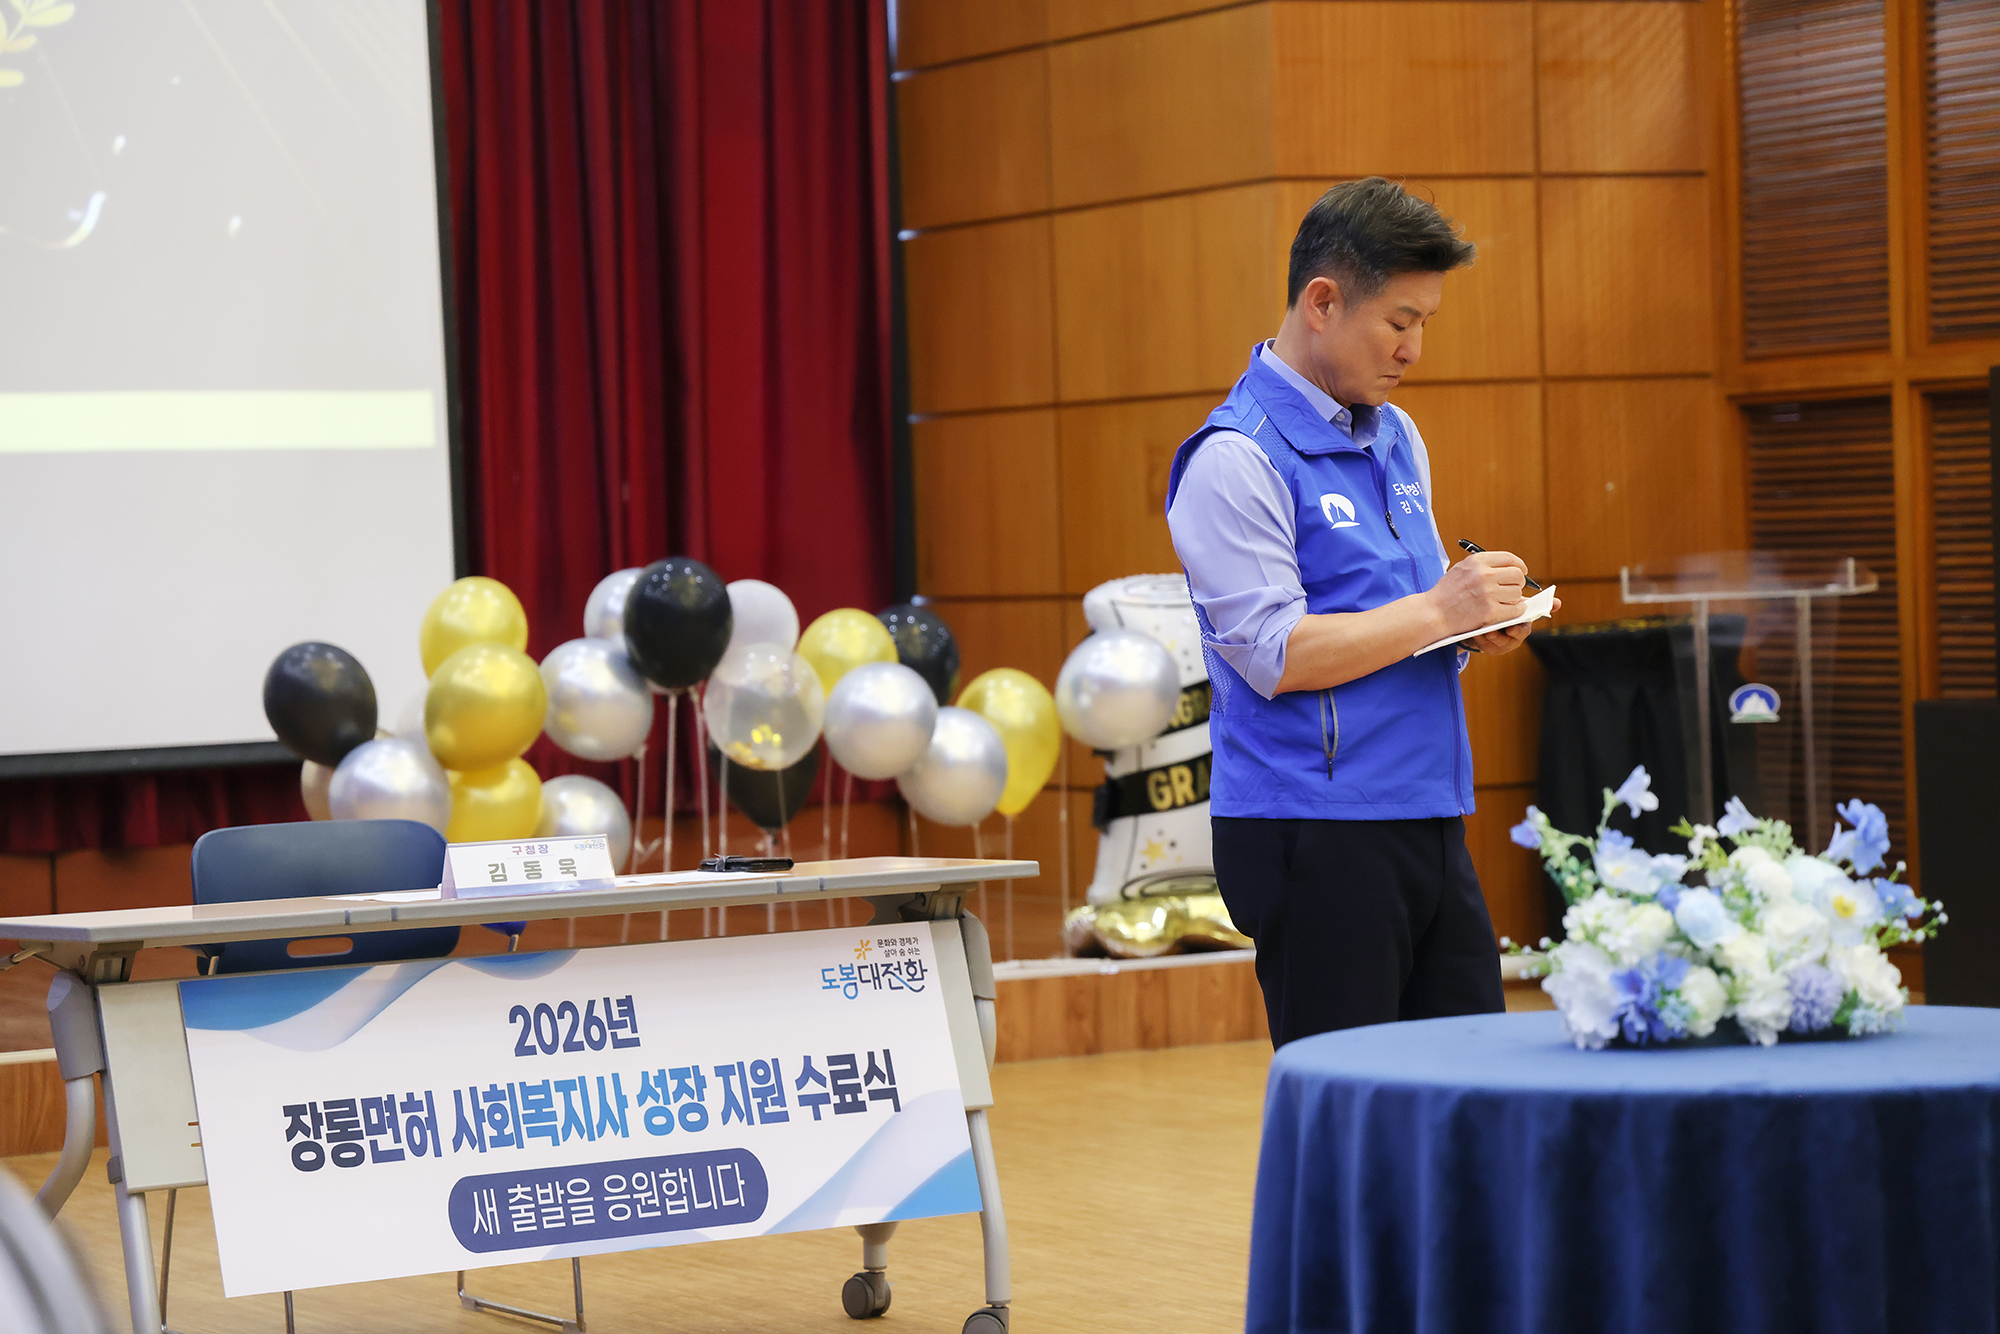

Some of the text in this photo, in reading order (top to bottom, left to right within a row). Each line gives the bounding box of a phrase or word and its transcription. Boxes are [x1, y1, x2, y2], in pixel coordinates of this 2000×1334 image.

[511, 844, 549, 856] 구청장
[877, 937, 919, 948] 문화와 경제가
[907, 947, 921, 956] 쉬는
[821, 958, 928, 1000] 도봉대전환
[509, 995, 641, 1057] 2026년
[282, 1049, 901, 1172] 장롱면허 사회복지사 성장 지원 수료식
[472, 1162, 745, 1236] 새 출발을 응원합니다
